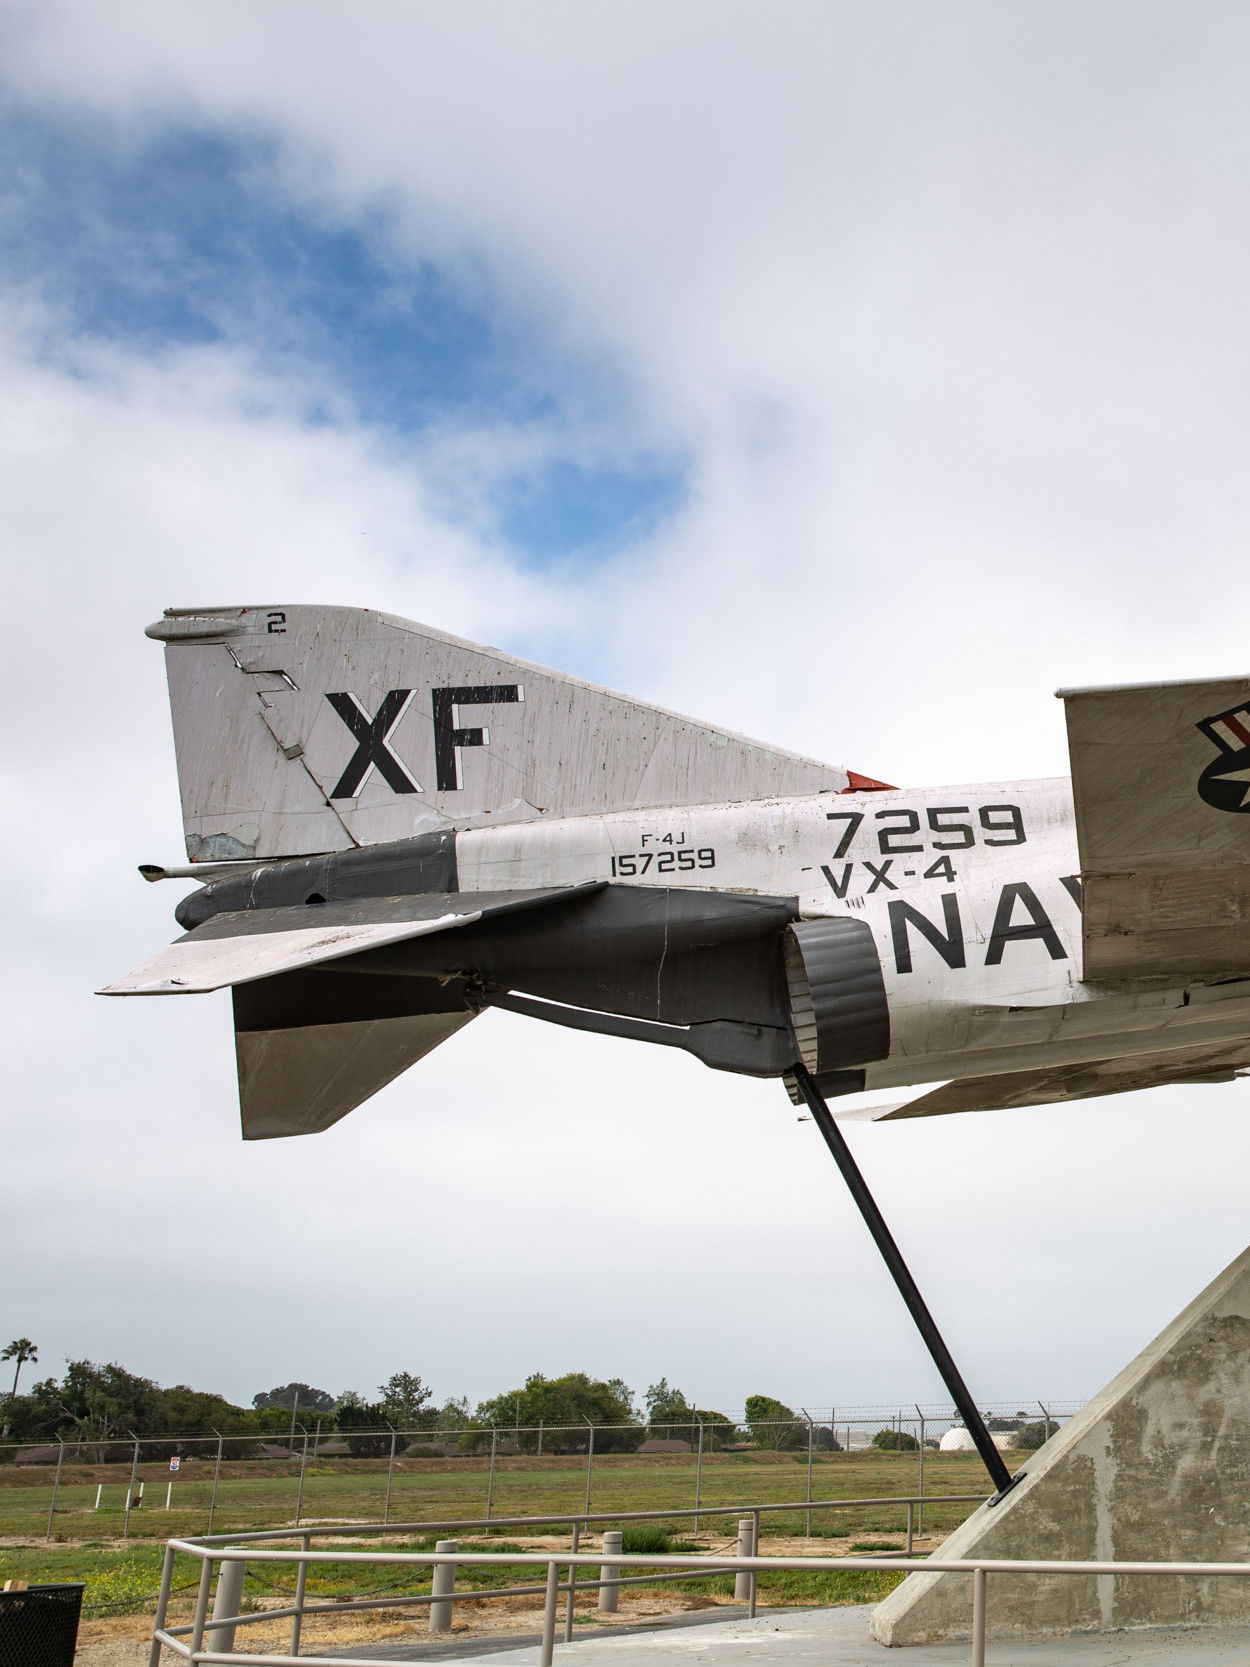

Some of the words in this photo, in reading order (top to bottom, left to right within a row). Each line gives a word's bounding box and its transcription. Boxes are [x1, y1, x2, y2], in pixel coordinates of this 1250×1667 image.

[267, 612, 287, 633] 2
[326, 684, 526, 799] XF
[641, 832, 685, 848] F-4J
[827, 804, 1027, 859] 7259
[611, 848, 716, 877] 157259
[820, 855, 958, 899] VX-4
